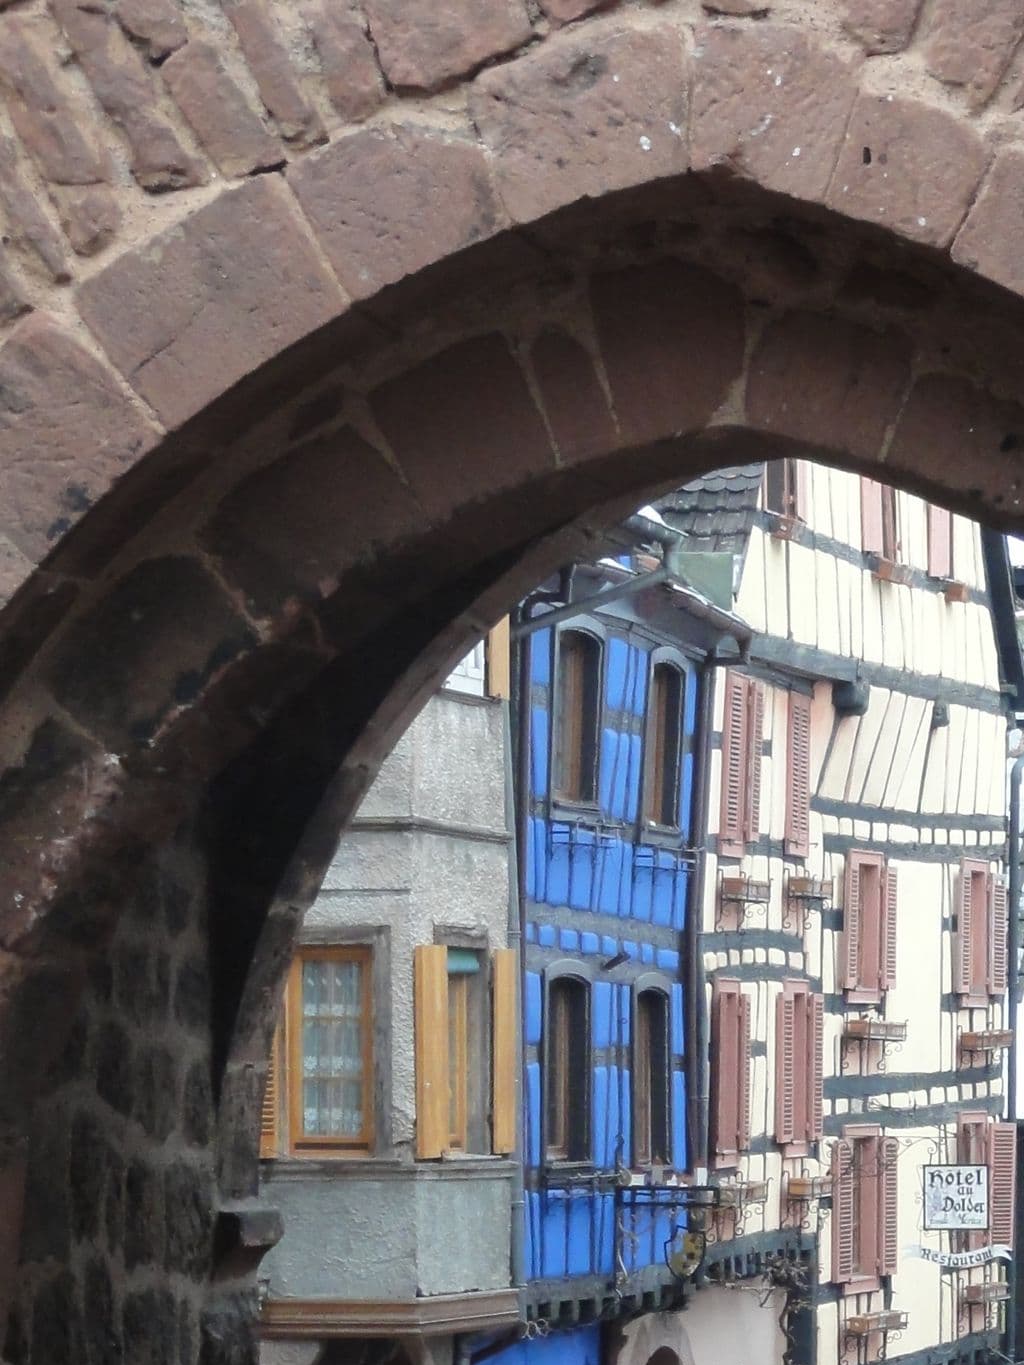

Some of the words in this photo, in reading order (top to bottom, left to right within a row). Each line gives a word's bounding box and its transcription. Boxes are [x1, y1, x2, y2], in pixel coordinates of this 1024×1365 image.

[957, 1186, 973, 1196] au
[942, 1196, 985, 1213] Dolder
[920, 1248, 993, 1266] Restaurant
